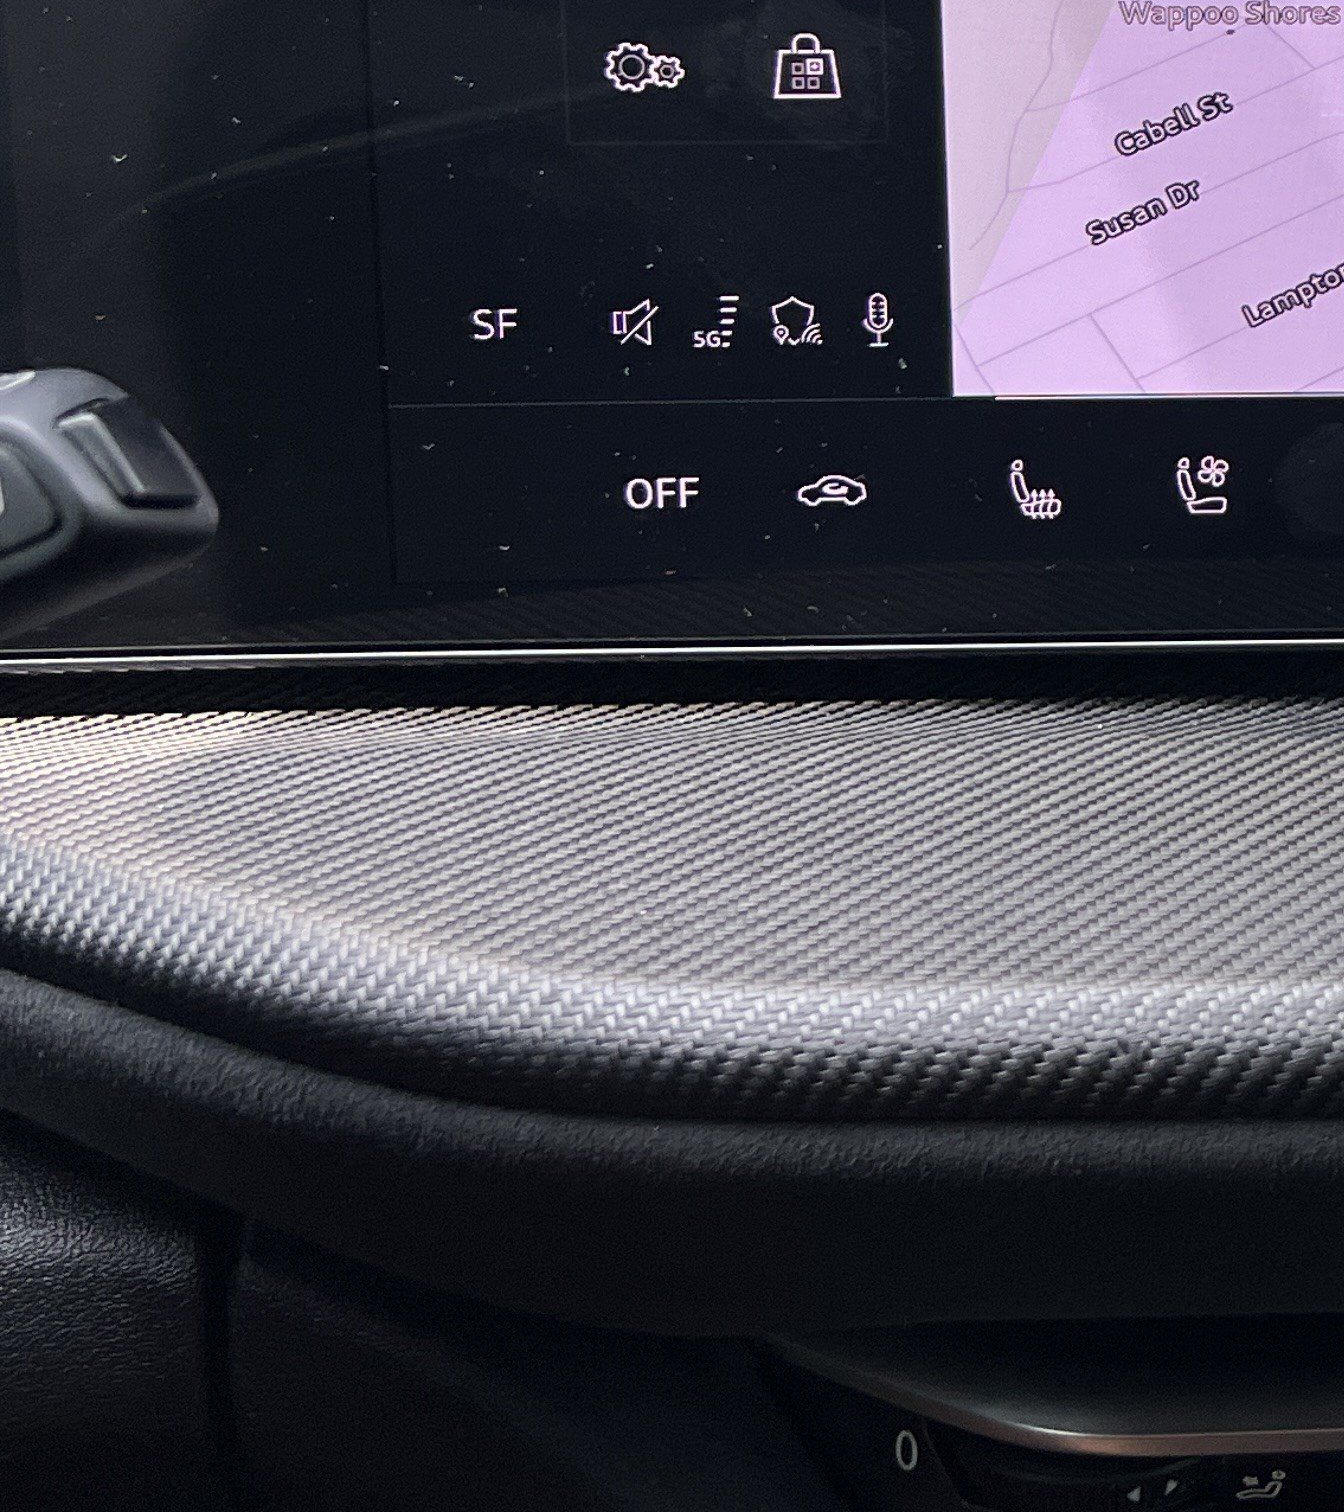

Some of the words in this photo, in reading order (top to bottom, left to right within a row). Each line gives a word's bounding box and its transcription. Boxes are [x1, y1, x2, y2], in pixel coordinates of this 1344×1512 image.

[1118, 0, 1239, 31] Wappoo
[1244, 0, 1341, 26] Shores
[1114, 104, 1200, 157] Cabell
[1197, 91, 1234, 122] St
[1085, 197, 1166, 245] Susan
[1165, 179, 1200, 211] Dr
[471, 307, 518, 340] SF
[692, 330, 721, 348] 5G
[624, 476, 701, 509] OFF
